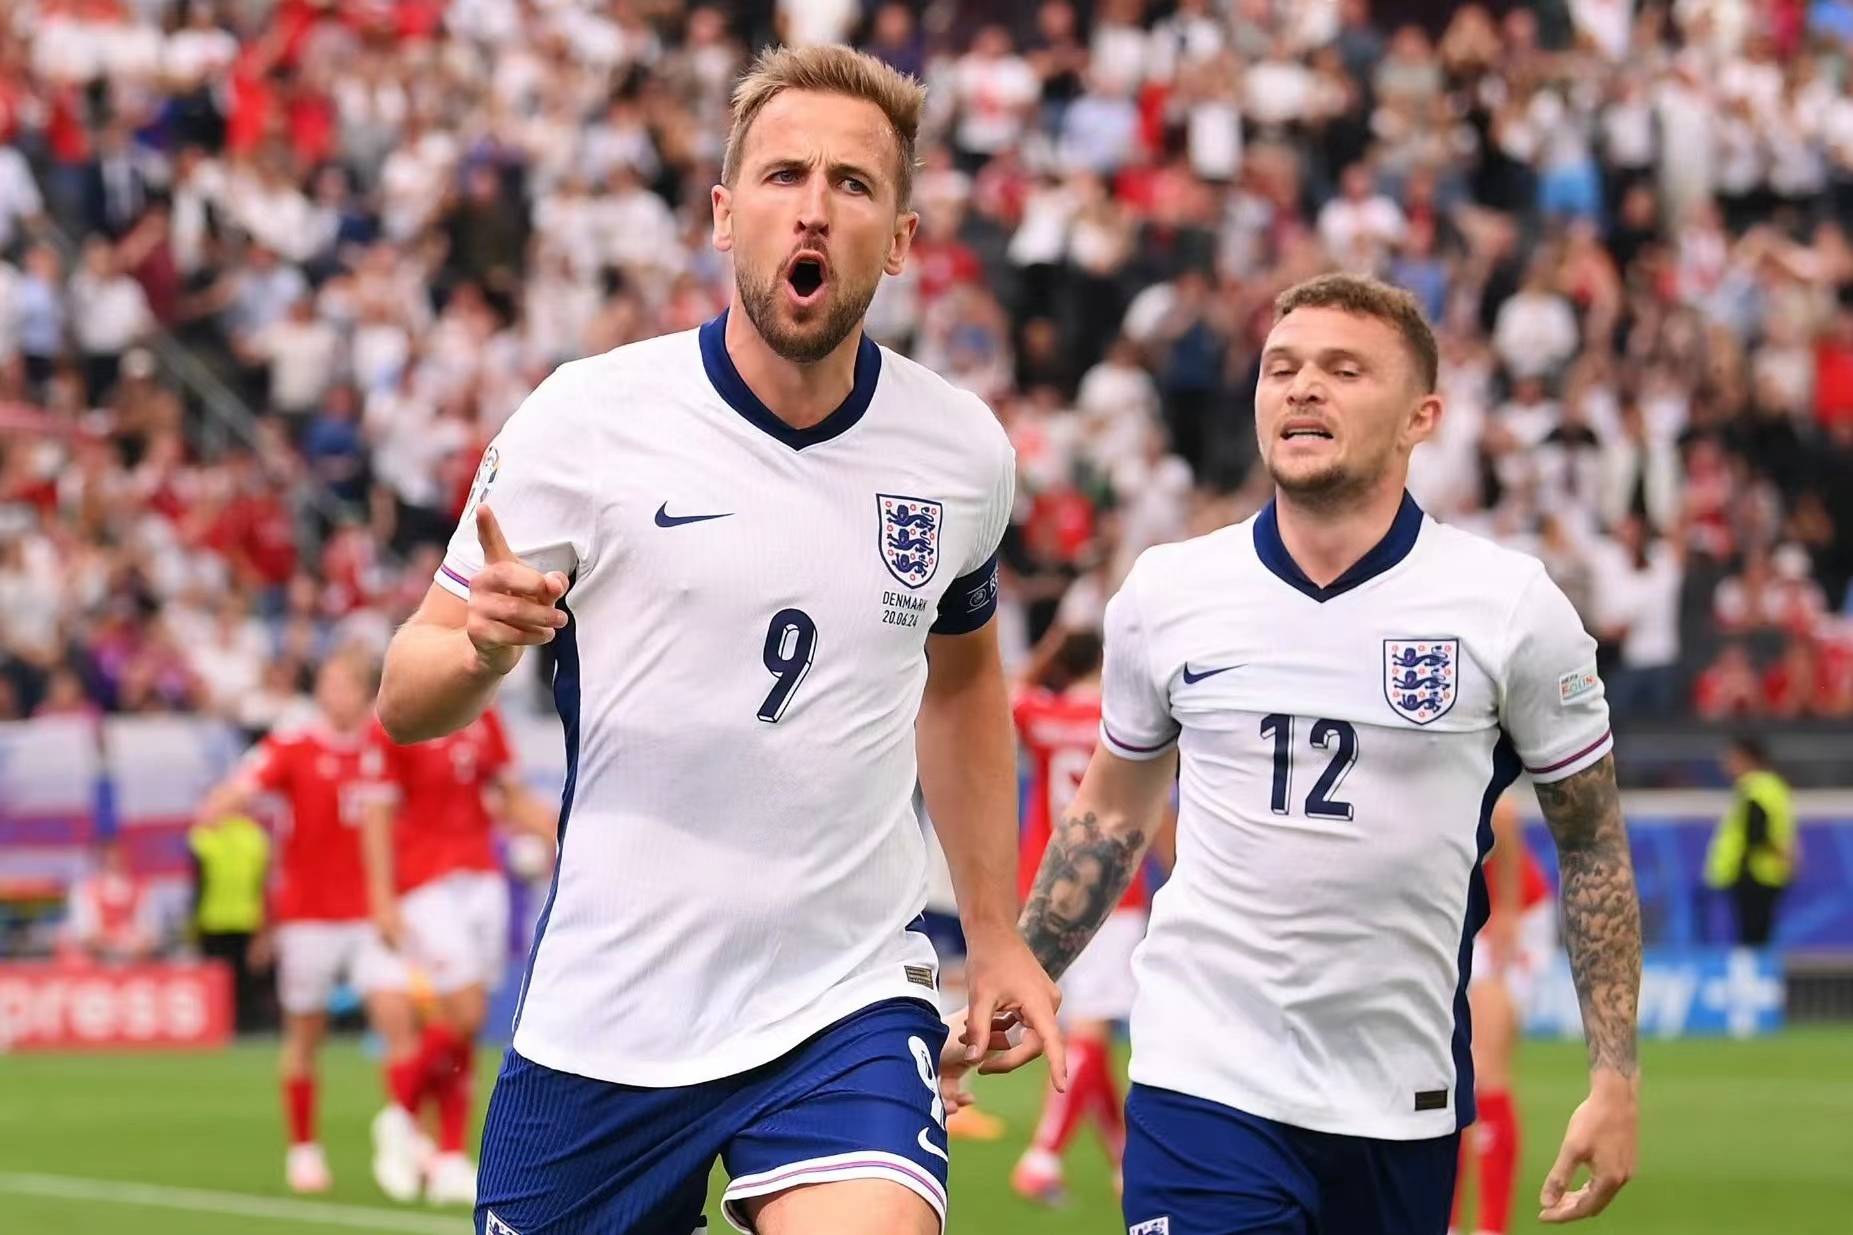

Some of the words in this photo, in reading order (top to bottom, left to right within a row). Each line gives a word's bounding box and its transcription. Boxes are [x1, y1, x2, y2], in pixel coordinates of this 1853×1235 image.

[882, 591, 928, 611] DENMARK
[757, 608, 818, 723] 9
[1260, 713, 1359, 822] 12
